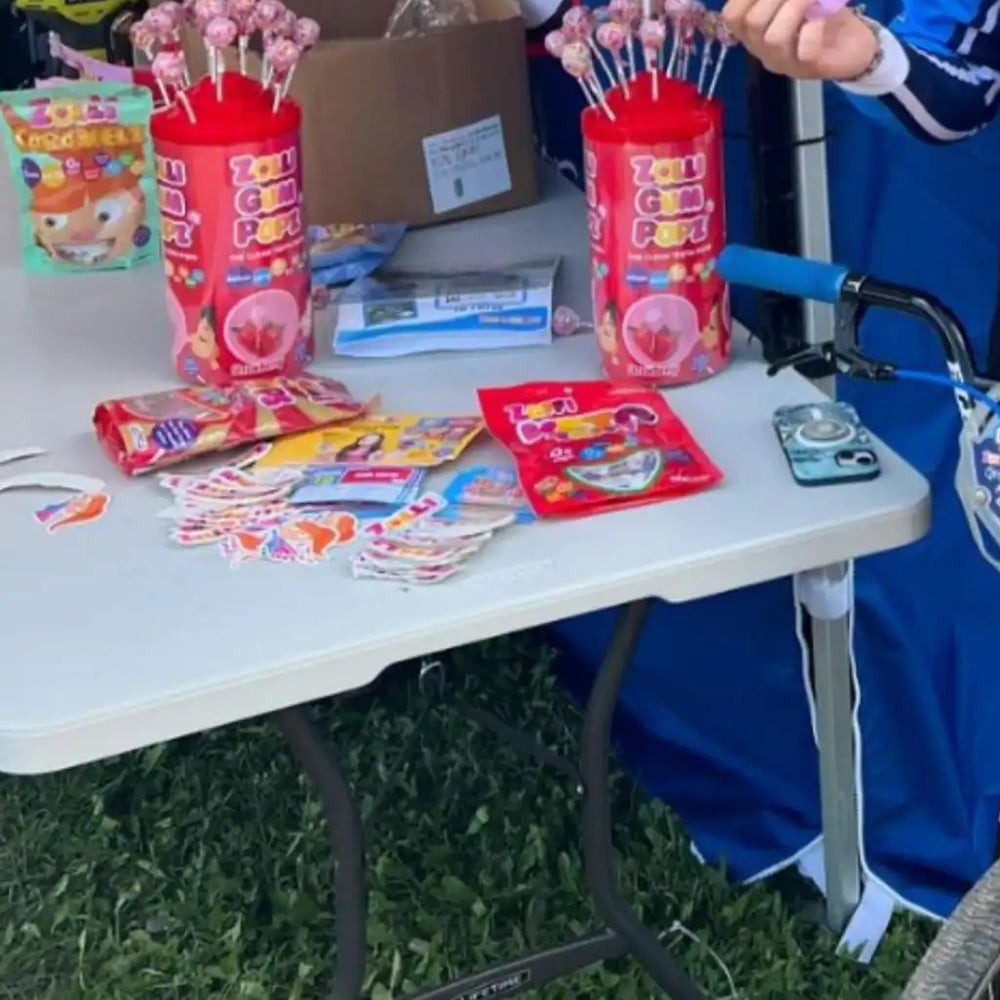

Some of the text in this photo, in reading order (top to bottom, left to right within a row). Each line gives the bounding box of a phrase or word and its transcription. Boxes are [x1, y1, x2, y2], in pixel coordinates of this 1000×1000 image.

[229, 146, 298, 187] ZOLLI
[630, 152, 706, 187] ZOLLI
[233, 177, 299, 218] GUM
[634, 184, 705, 218] GUM
[631, 213, 709, 249] POPZ
